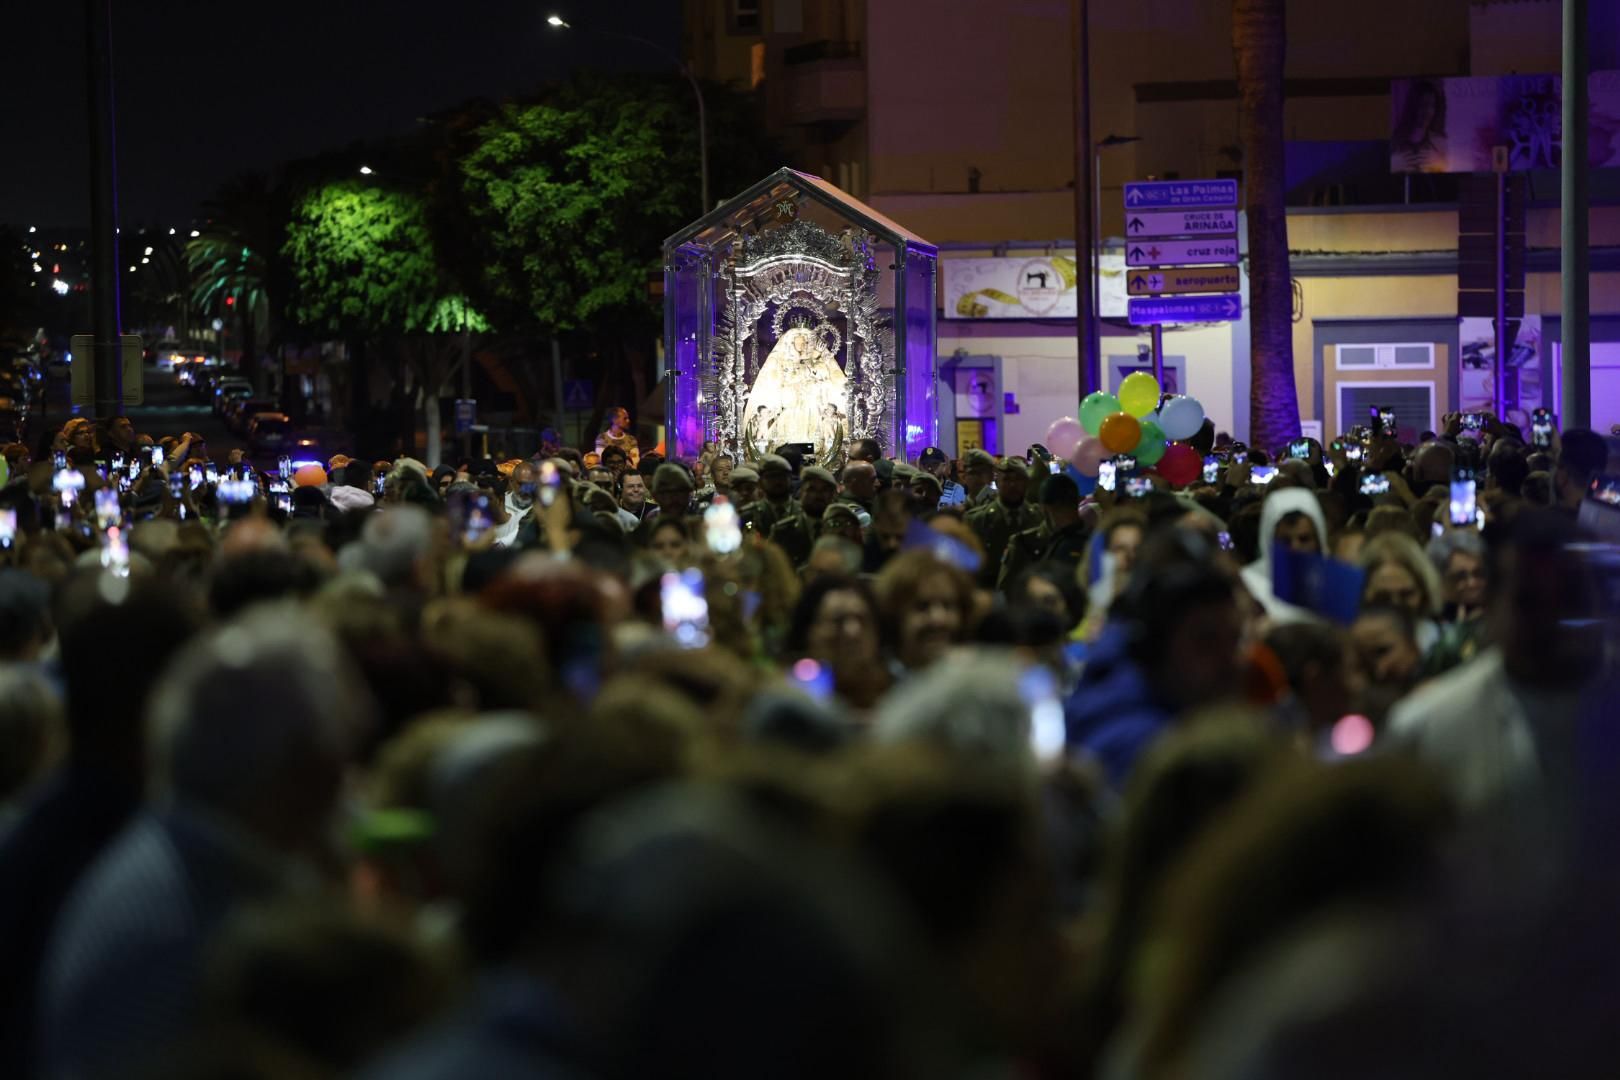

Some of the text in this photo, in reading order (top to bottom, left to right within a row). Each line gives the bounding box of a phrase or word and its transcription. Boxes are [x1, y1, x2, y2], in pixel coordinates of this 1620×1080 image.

[1170, 184, 1233, 195] Las Palmas
[1184, 213, 1211, 221] CRUCE
[1184, 220, 1234, 231] ARINAGA
[1187, 245, 1235, 257] cruz roja
[1175, 274, 1237, 287] aeropuerto
[1132, 305, 1195, 316] Maspalomas
